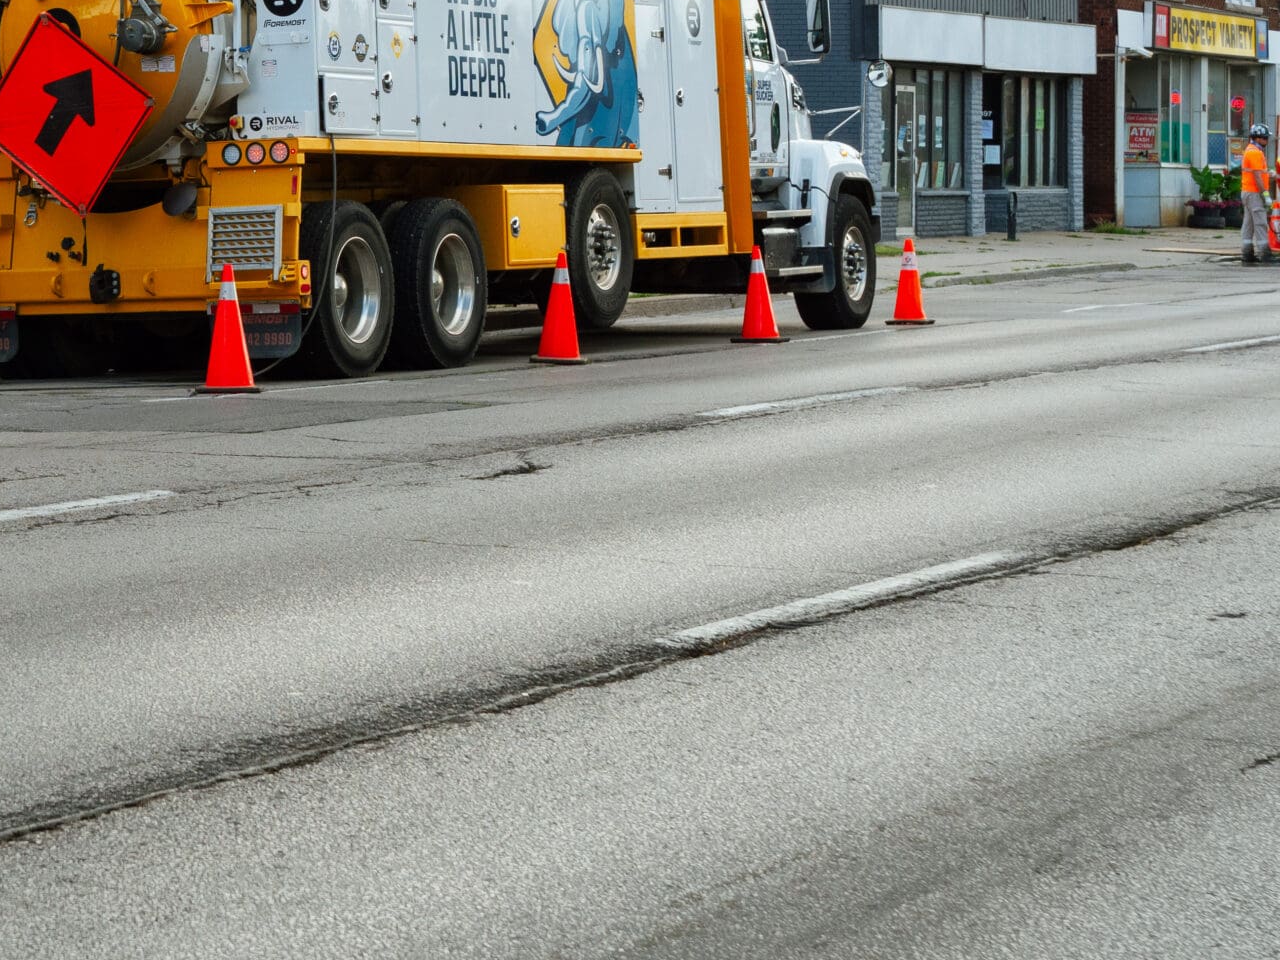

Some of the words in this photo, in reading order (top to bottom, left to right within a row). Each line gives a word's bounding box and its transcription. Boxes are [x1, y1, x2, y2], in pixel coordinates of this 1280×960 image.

[264, 19, 306, 28] FOREMOST
[447, 9, 458, 50] A
[461, 10, 510, 54] LITTLE
[1171, 15, 1217, 47] PROSPECT
[1219, 22, 1253, 49] VARIETY
[448, 55, 511, 99] DEEPER.
[267, 117, 299, 125] RIVAL
[1131, 127, 1155, 136] ATM
